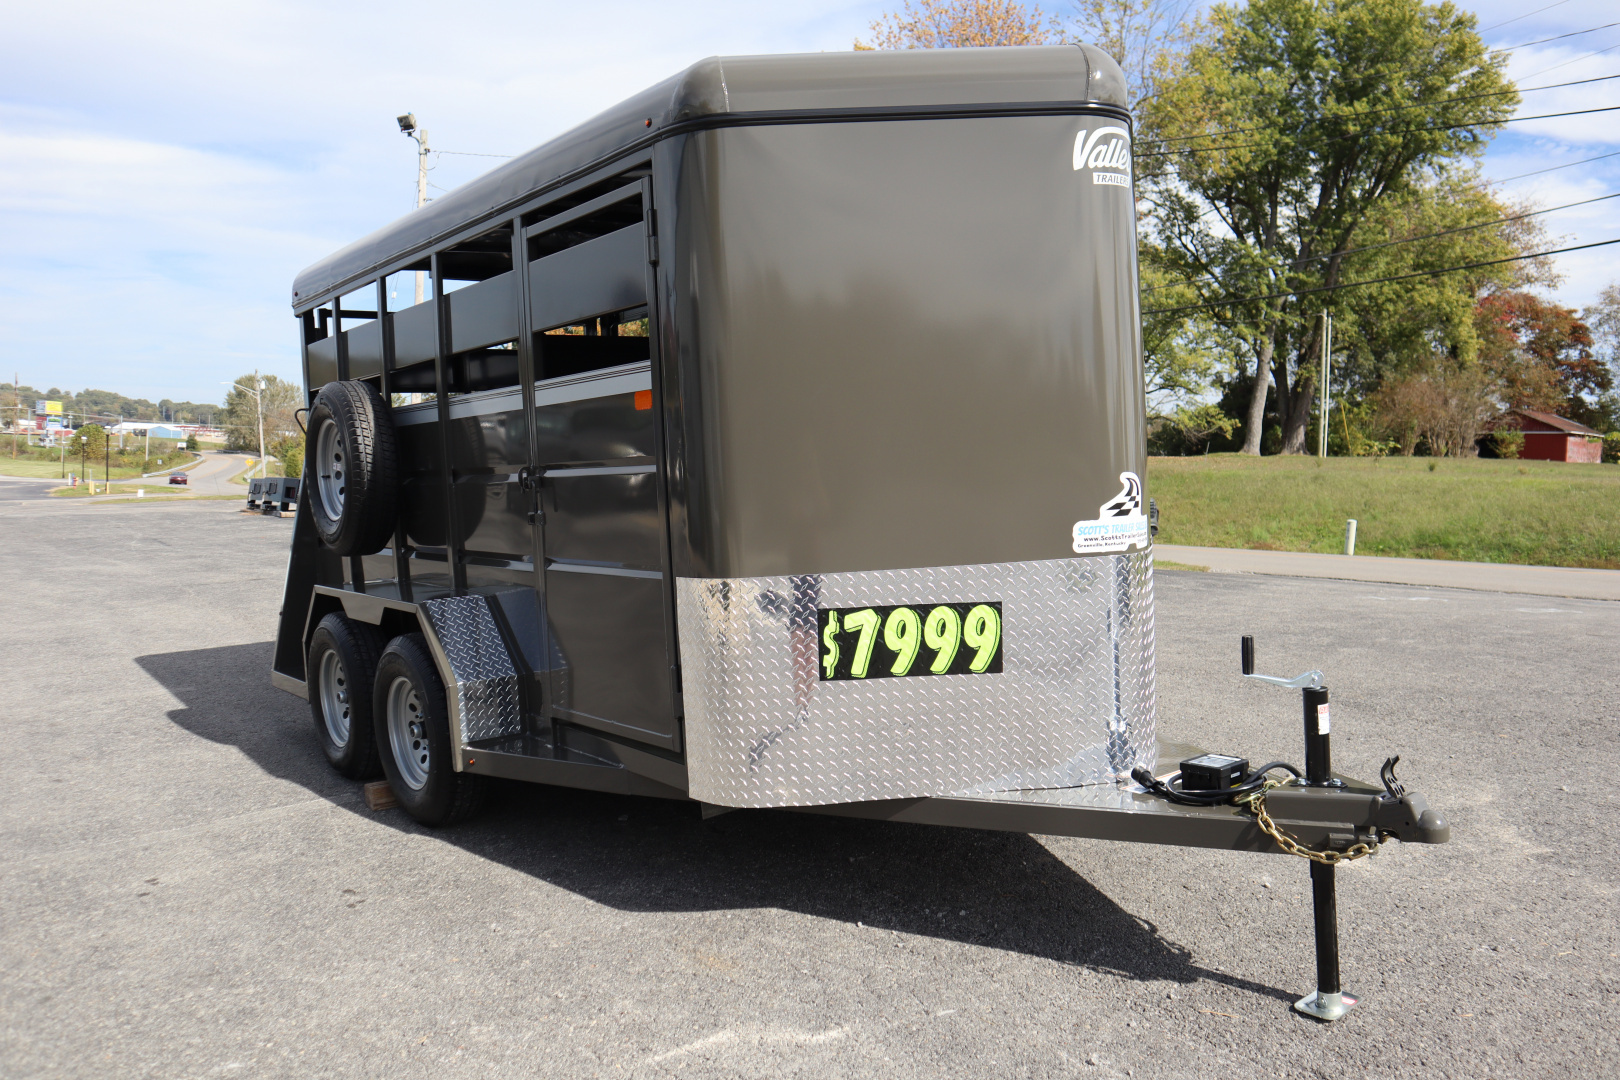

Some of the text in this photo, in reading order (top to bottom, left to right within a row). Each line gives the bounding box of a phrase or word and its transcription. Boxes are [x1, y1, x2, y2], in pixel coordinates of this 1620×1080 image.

[1078, 525, 1110, 536] SCOTT'S
[1111, 523, 1134, 534] TRAILER
[823, 604, 1000, 679] $7999
